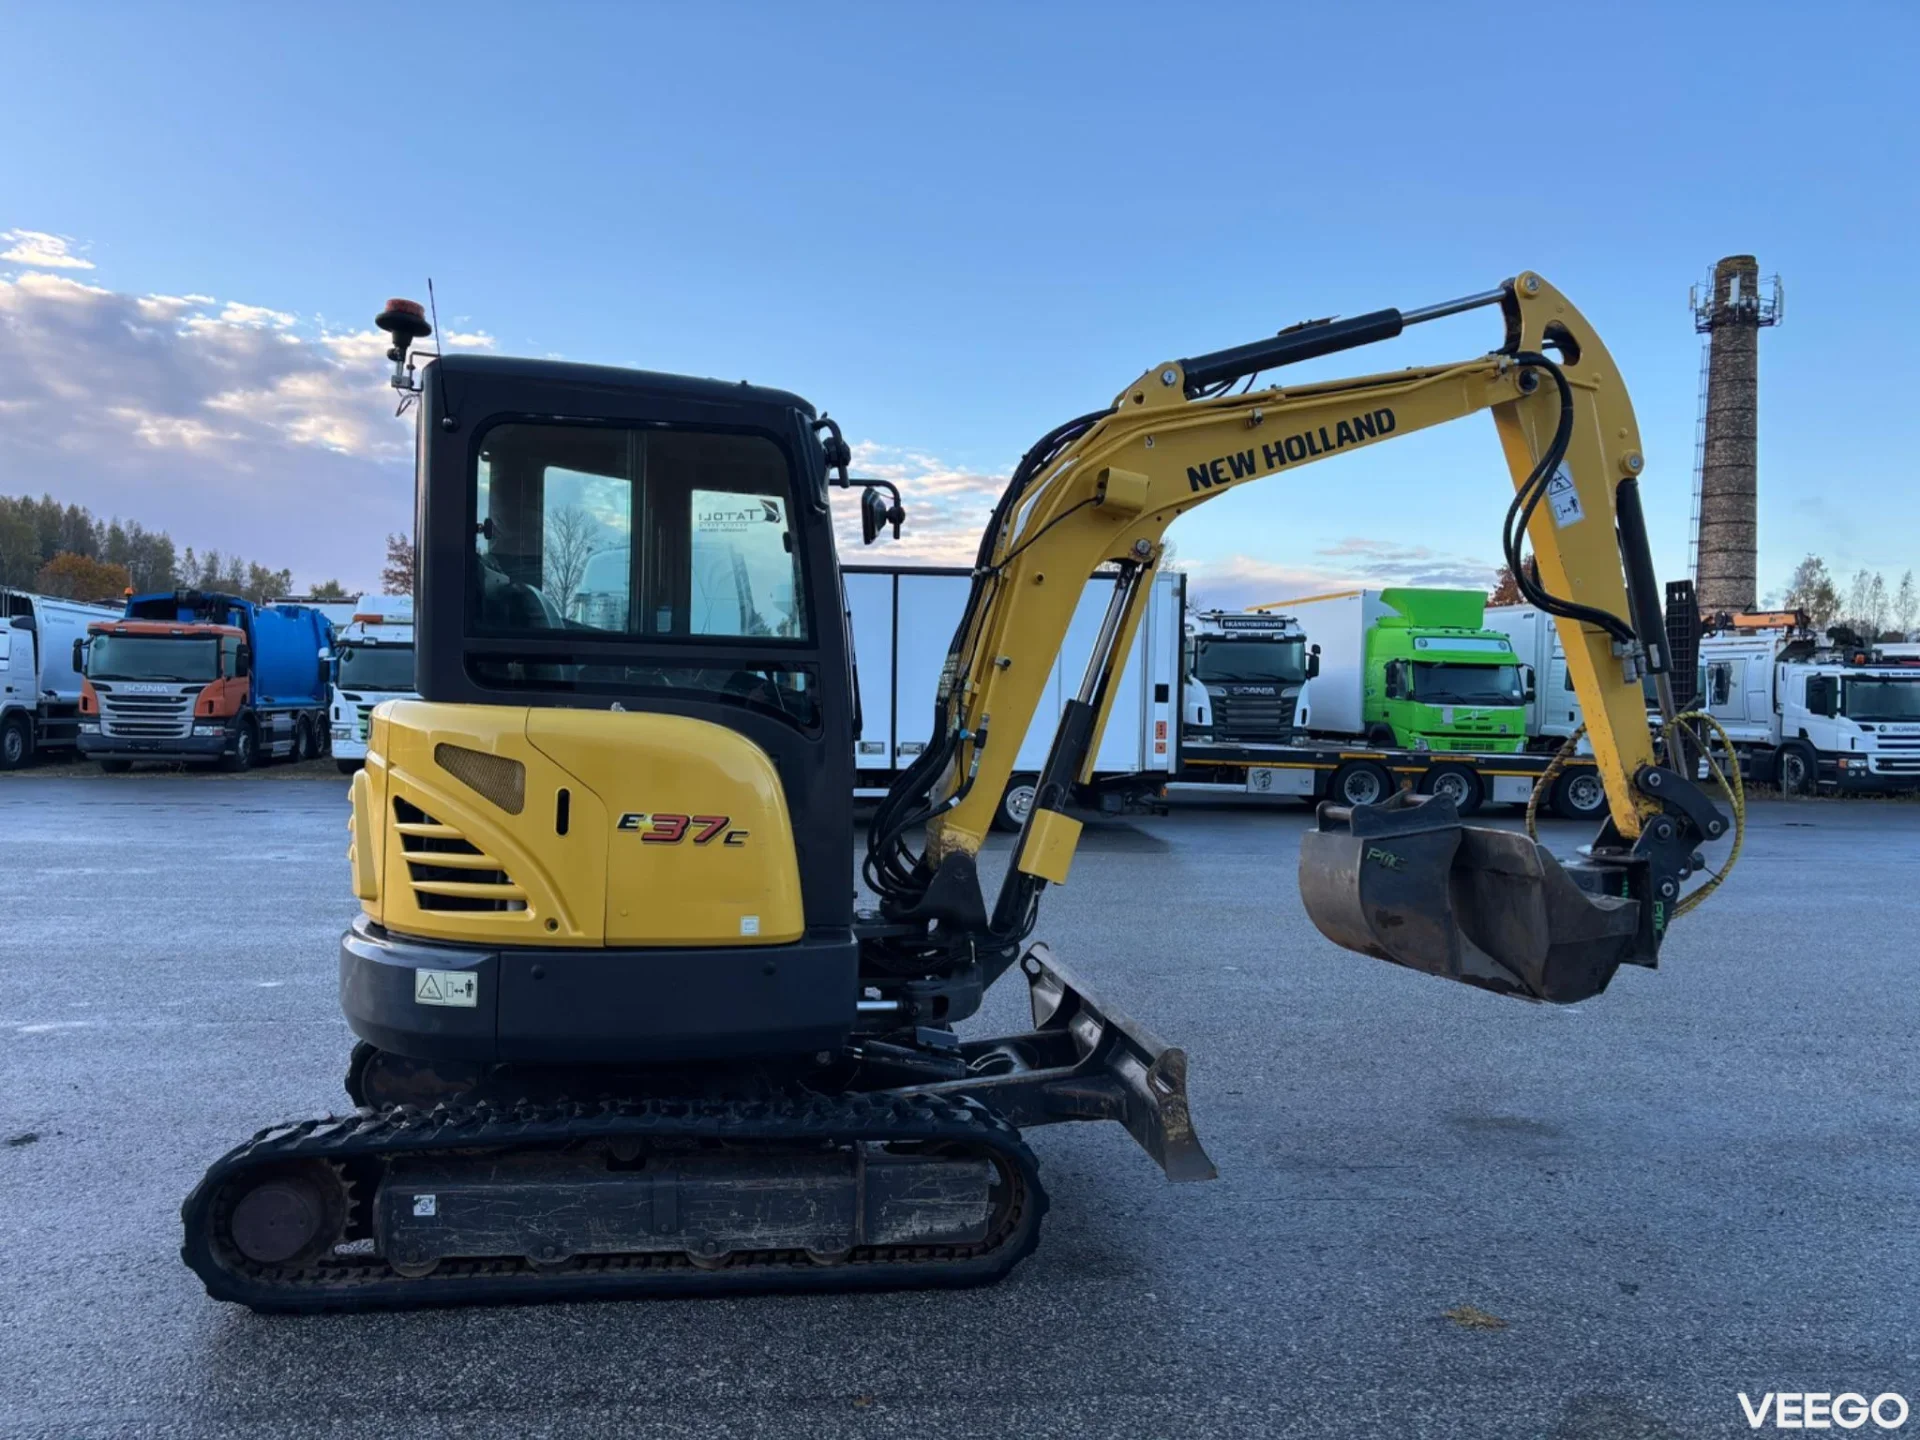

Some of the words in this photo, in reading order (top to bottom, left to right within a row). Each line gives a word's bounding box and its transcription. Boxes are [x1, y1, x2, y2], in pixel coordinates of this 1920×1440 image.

[1186, 448, 1257, 492] NEW
[1261, 407, 1396, 470] HOLLAND
[123, 683, 169, 693] SCANIA
[1233, 685, 1276, 695] SCANIA
